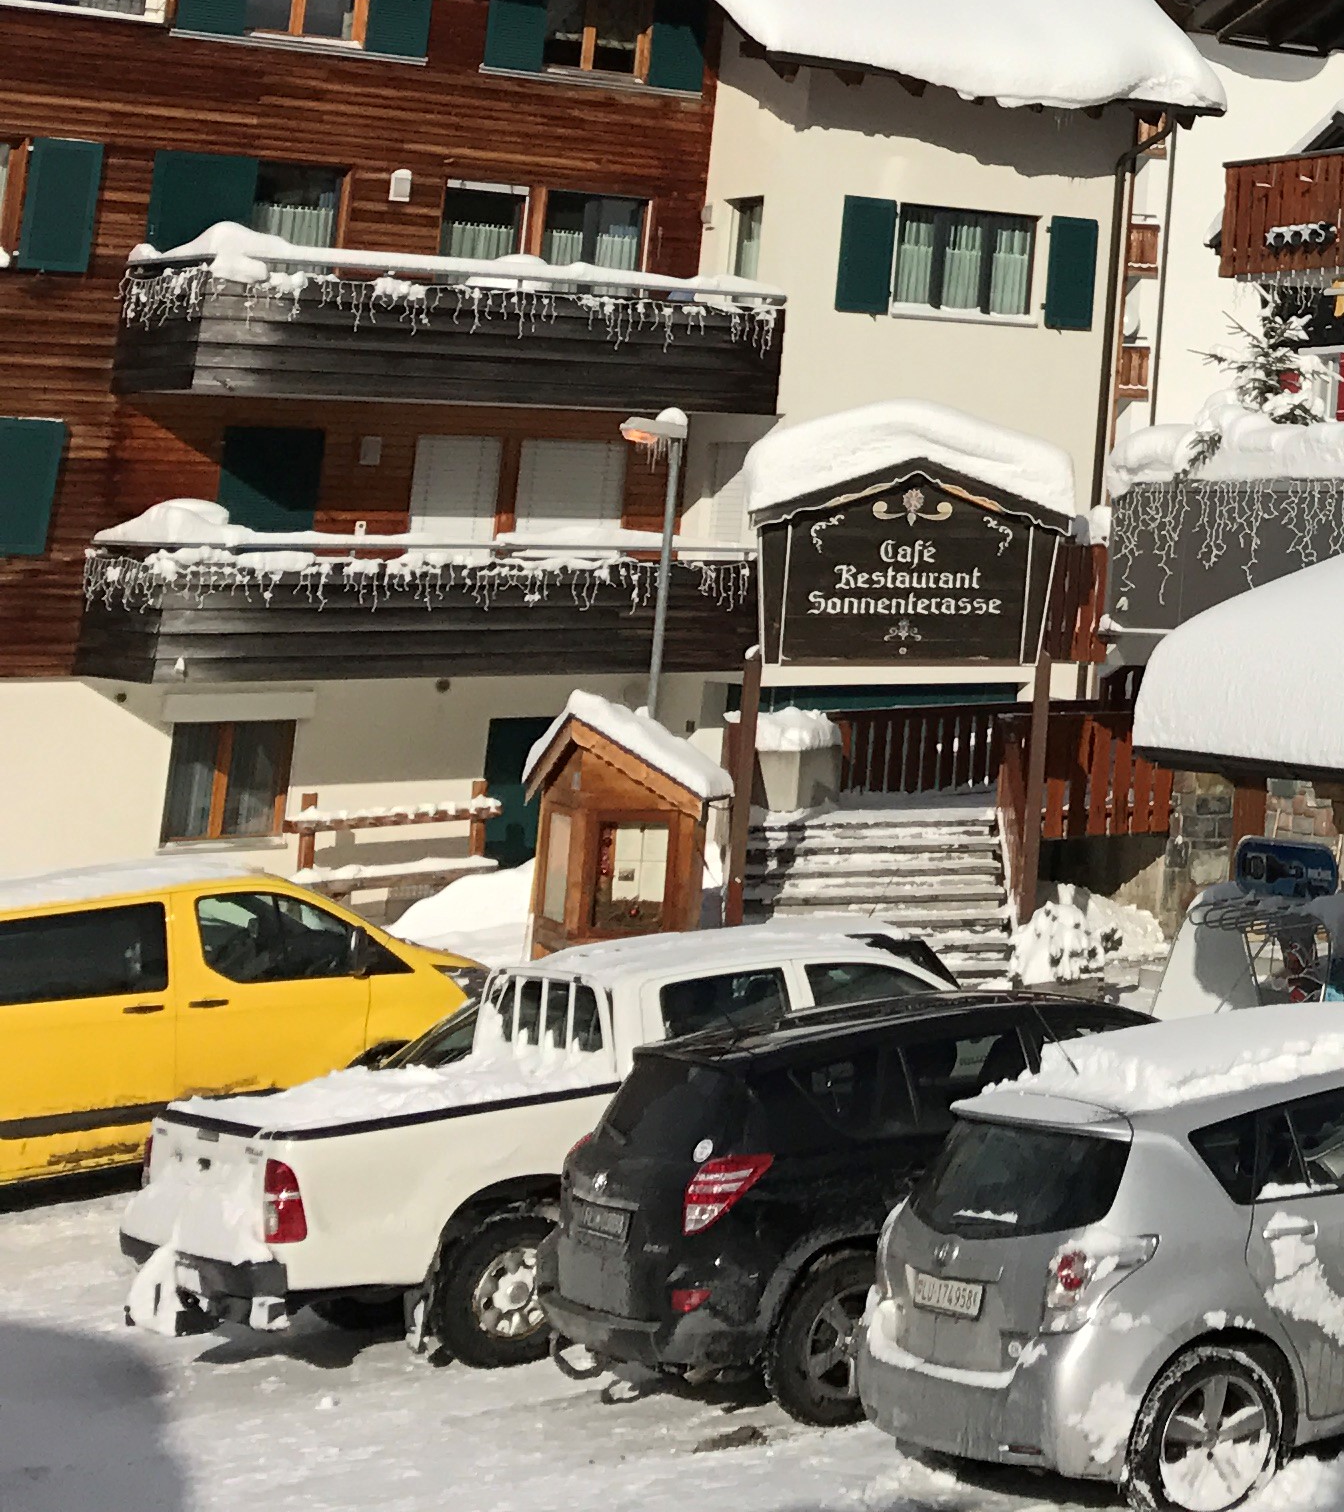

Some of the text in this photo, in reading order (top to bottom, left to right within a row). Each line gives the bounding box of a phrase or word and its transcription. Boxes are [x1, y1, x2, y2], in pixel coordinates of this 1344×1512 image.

[879, 539, 936, 569] Café
[834, 564, 982, 590] Restaurant
[807, 590, 1002, 615] Sonnenterasse
